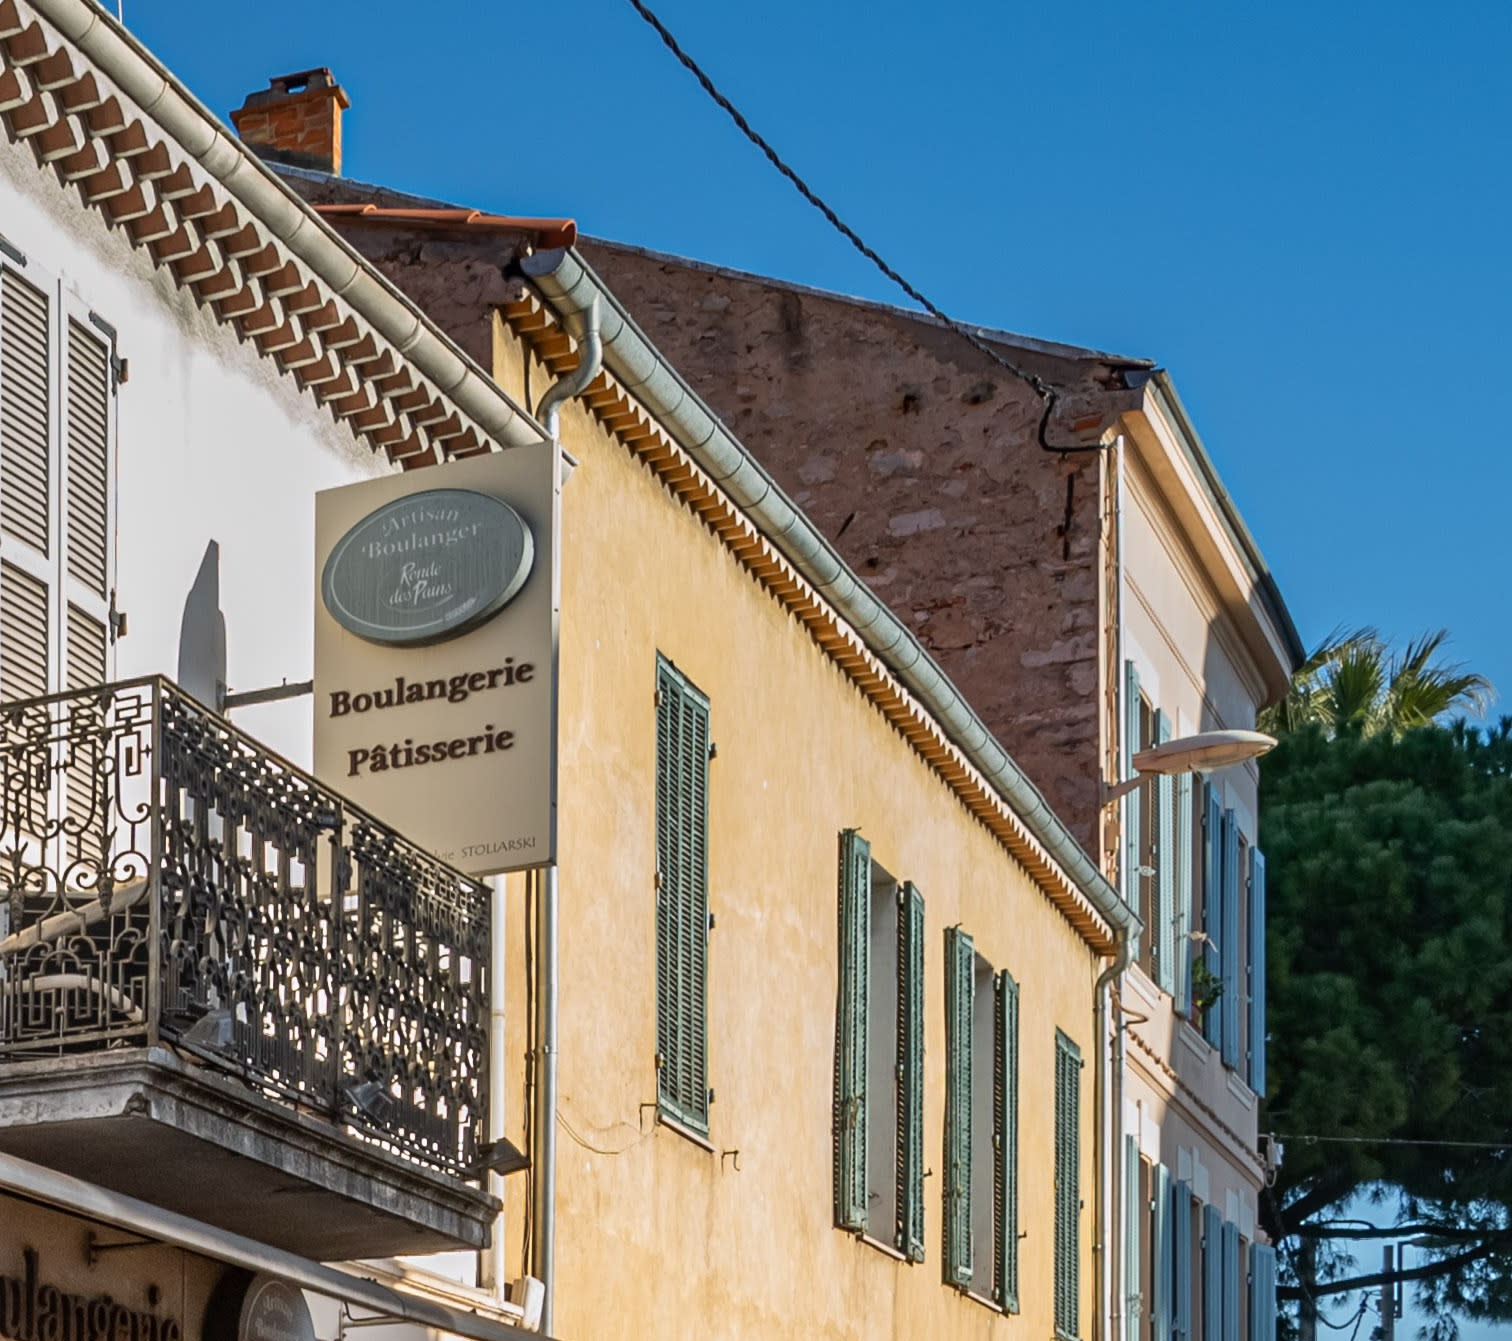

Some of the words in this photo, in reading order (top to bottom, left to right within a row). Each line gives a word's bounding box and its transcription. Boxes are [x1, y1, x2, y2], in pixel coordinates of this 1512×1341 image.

[382, 506, 459, 537] Artisan
[362, 522, 482, 559] Boulanger
[400, 560, 442, 586] Ronde
[329, 657, 535, 719] Boulangerie
[347, 725, 515, 777] Pâtisserie
[461, 837, 536, 858] STOLIARSKI
